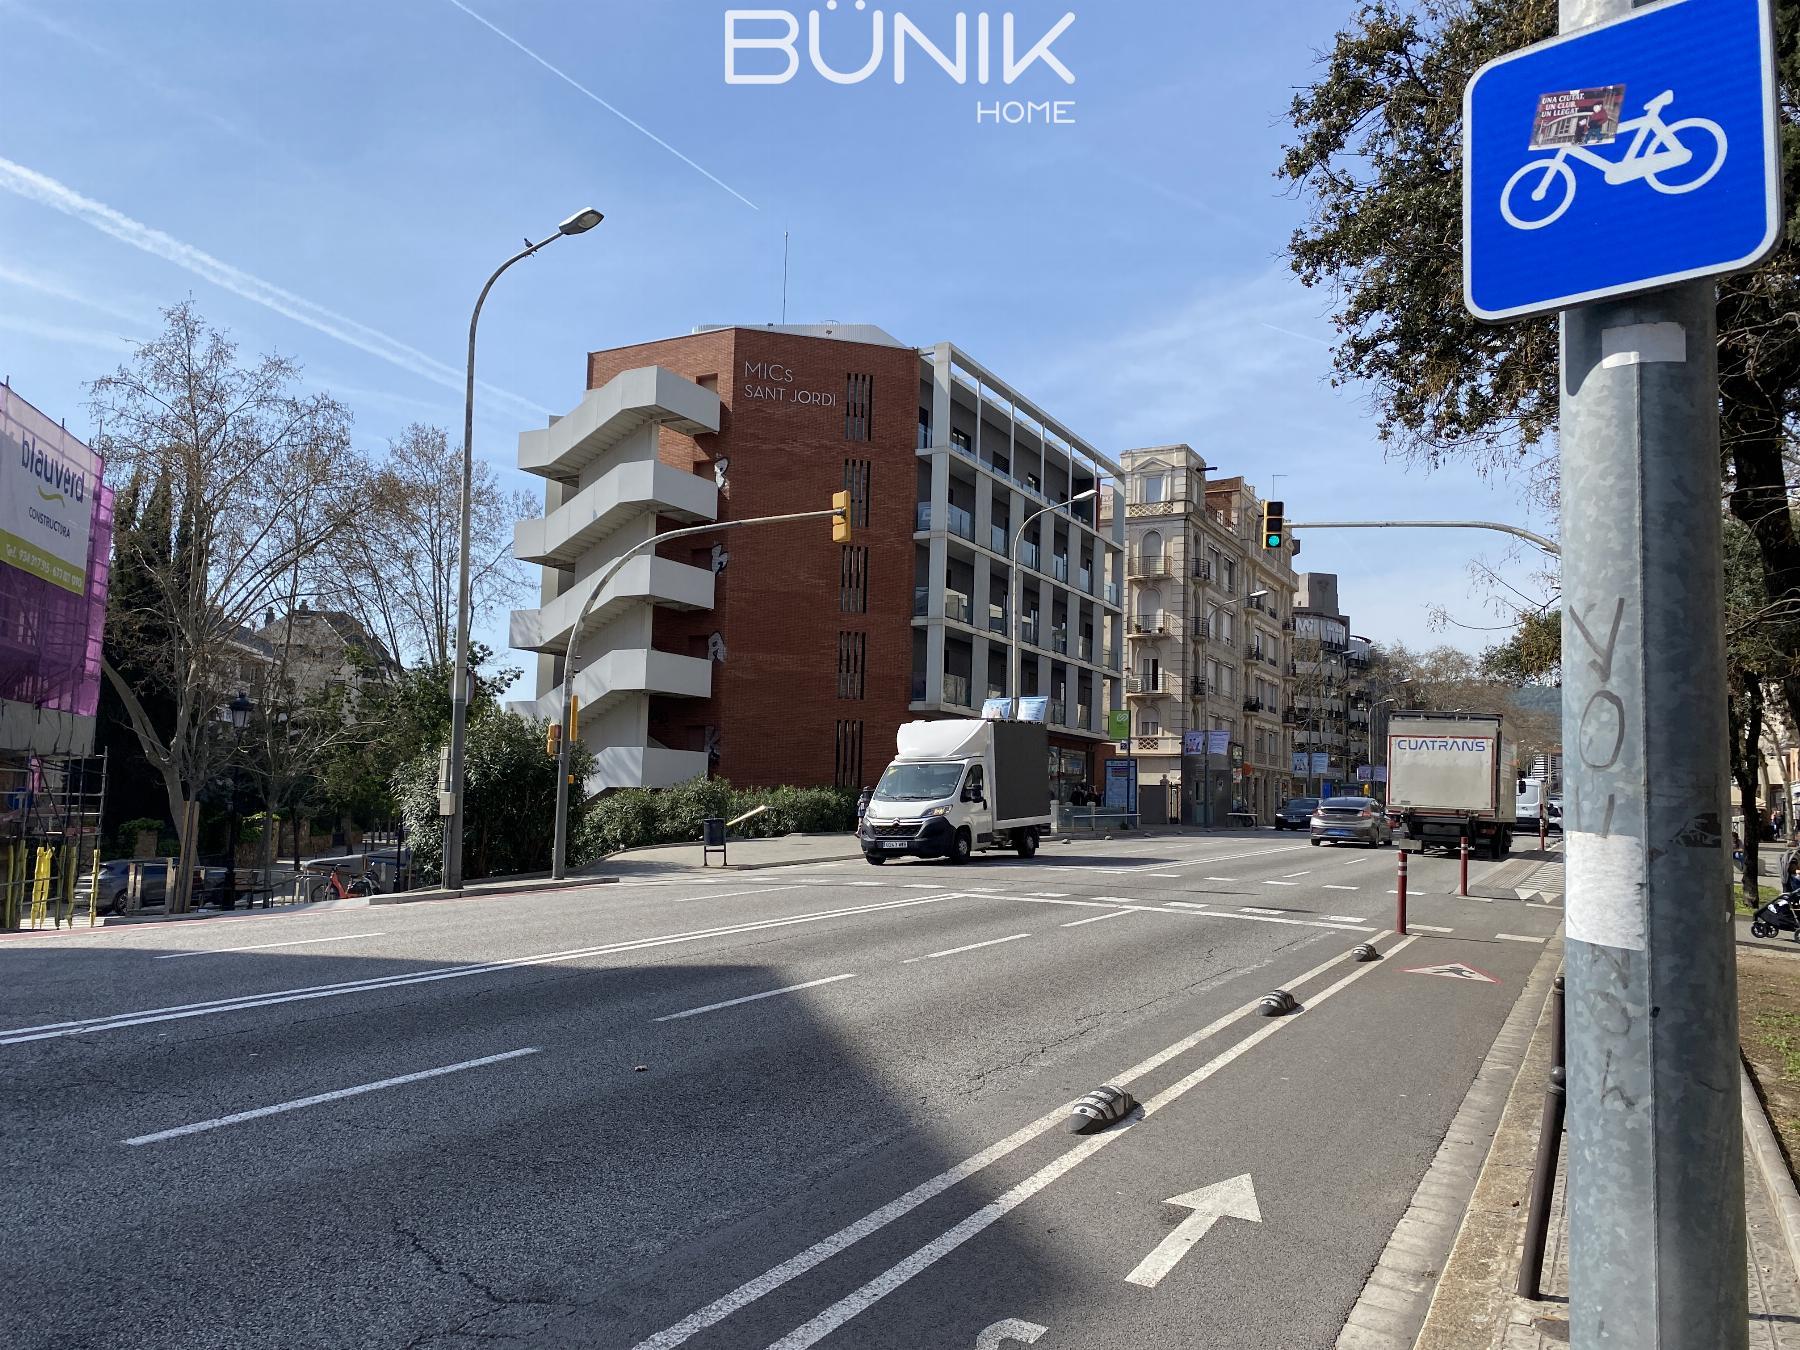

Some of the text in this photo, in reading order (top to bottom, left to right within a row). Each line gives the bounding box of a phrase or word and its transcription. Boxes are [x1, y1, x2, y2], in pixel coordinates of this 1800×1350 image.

[744, 384, 836, 407] SANT JORDI
[21, 430, 85, 504] blauverd
[28, 506, 71, 539] CONSTRUCTURA
[1397, 739, 1486, 752] CUATRANS
